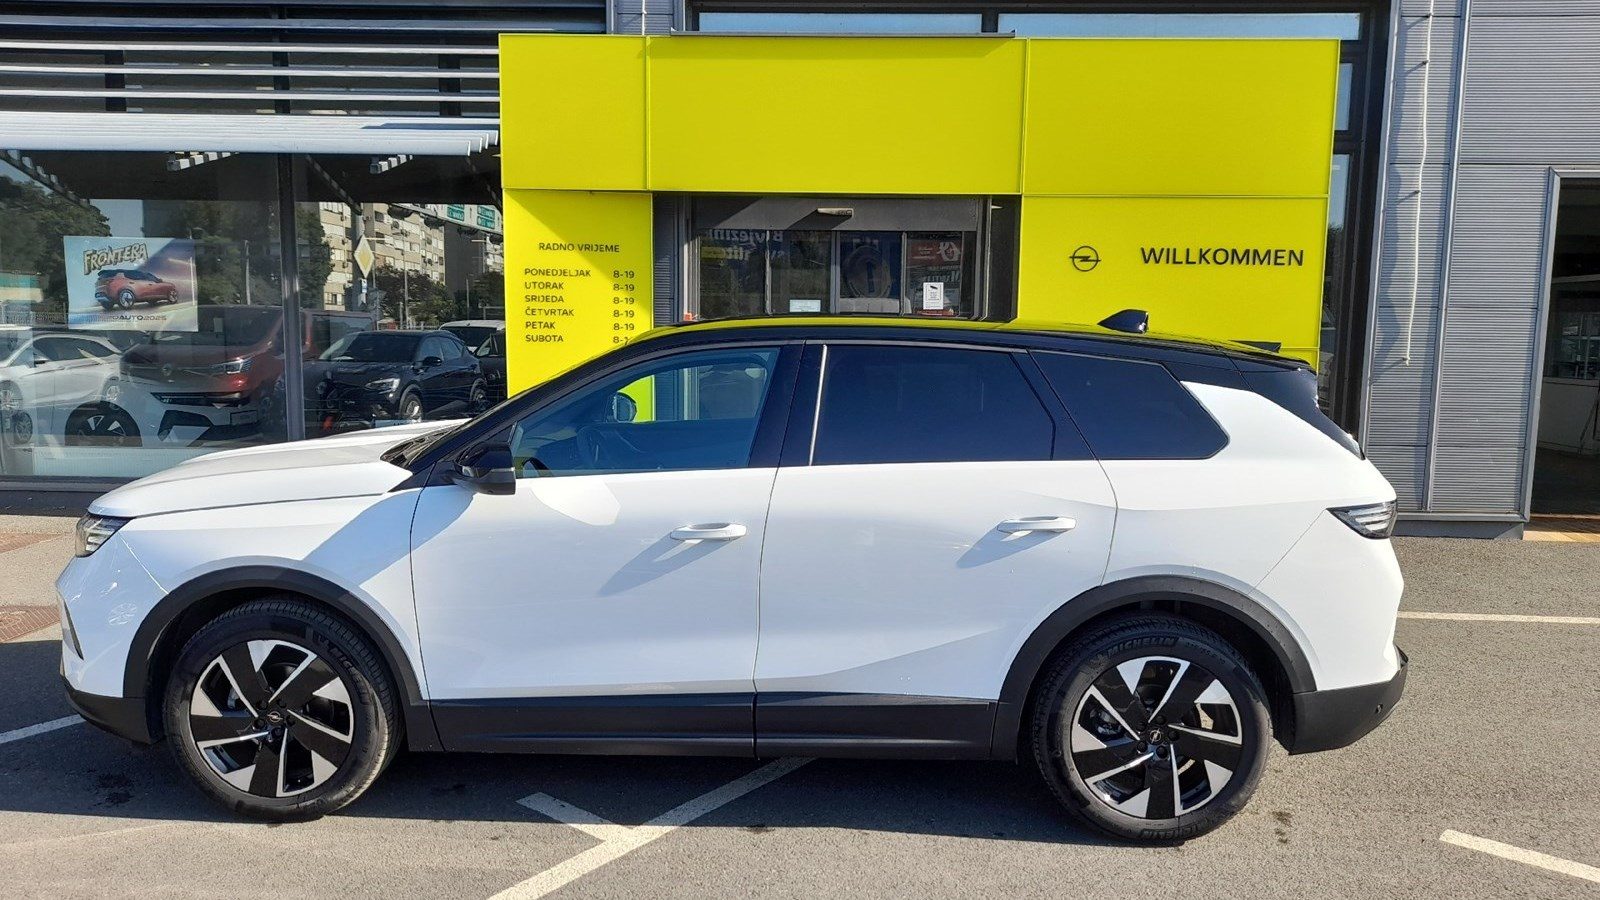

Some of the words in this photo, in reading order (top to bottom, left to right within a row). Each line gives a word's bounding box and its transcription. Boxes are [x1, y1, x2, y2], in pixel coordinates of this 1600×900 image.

[539, 242, 575, 251] RADNO
[577, 243, 620, 253] VRIJEME
[83, 242, 149, 275] FRONTERA
[1140, 247, 1304, 267] WILLKOMMEN
[524, 268, 591, 277] PONEDJELJAK
[613, 270, 635, 279] 8-19
[524, 281, 564, 290] UTORAK
[613, 283, 635, 292] 8-19
[524, 295, 565, 303] SRIJEDA
[613, 297, 635, 305] 8-19
[525, 307, 575, 317] ČETVRTAK
[613, 310, 635, 318] 8-19
[525, 321, 556, 330] PETAK
[613, 323, 635, 331] 8-19
[525, 334, 564, 343] SUBOTA
[613, 336, 630, 346] 8-1
[1107, 636, 1180, 658] MICHELIN
